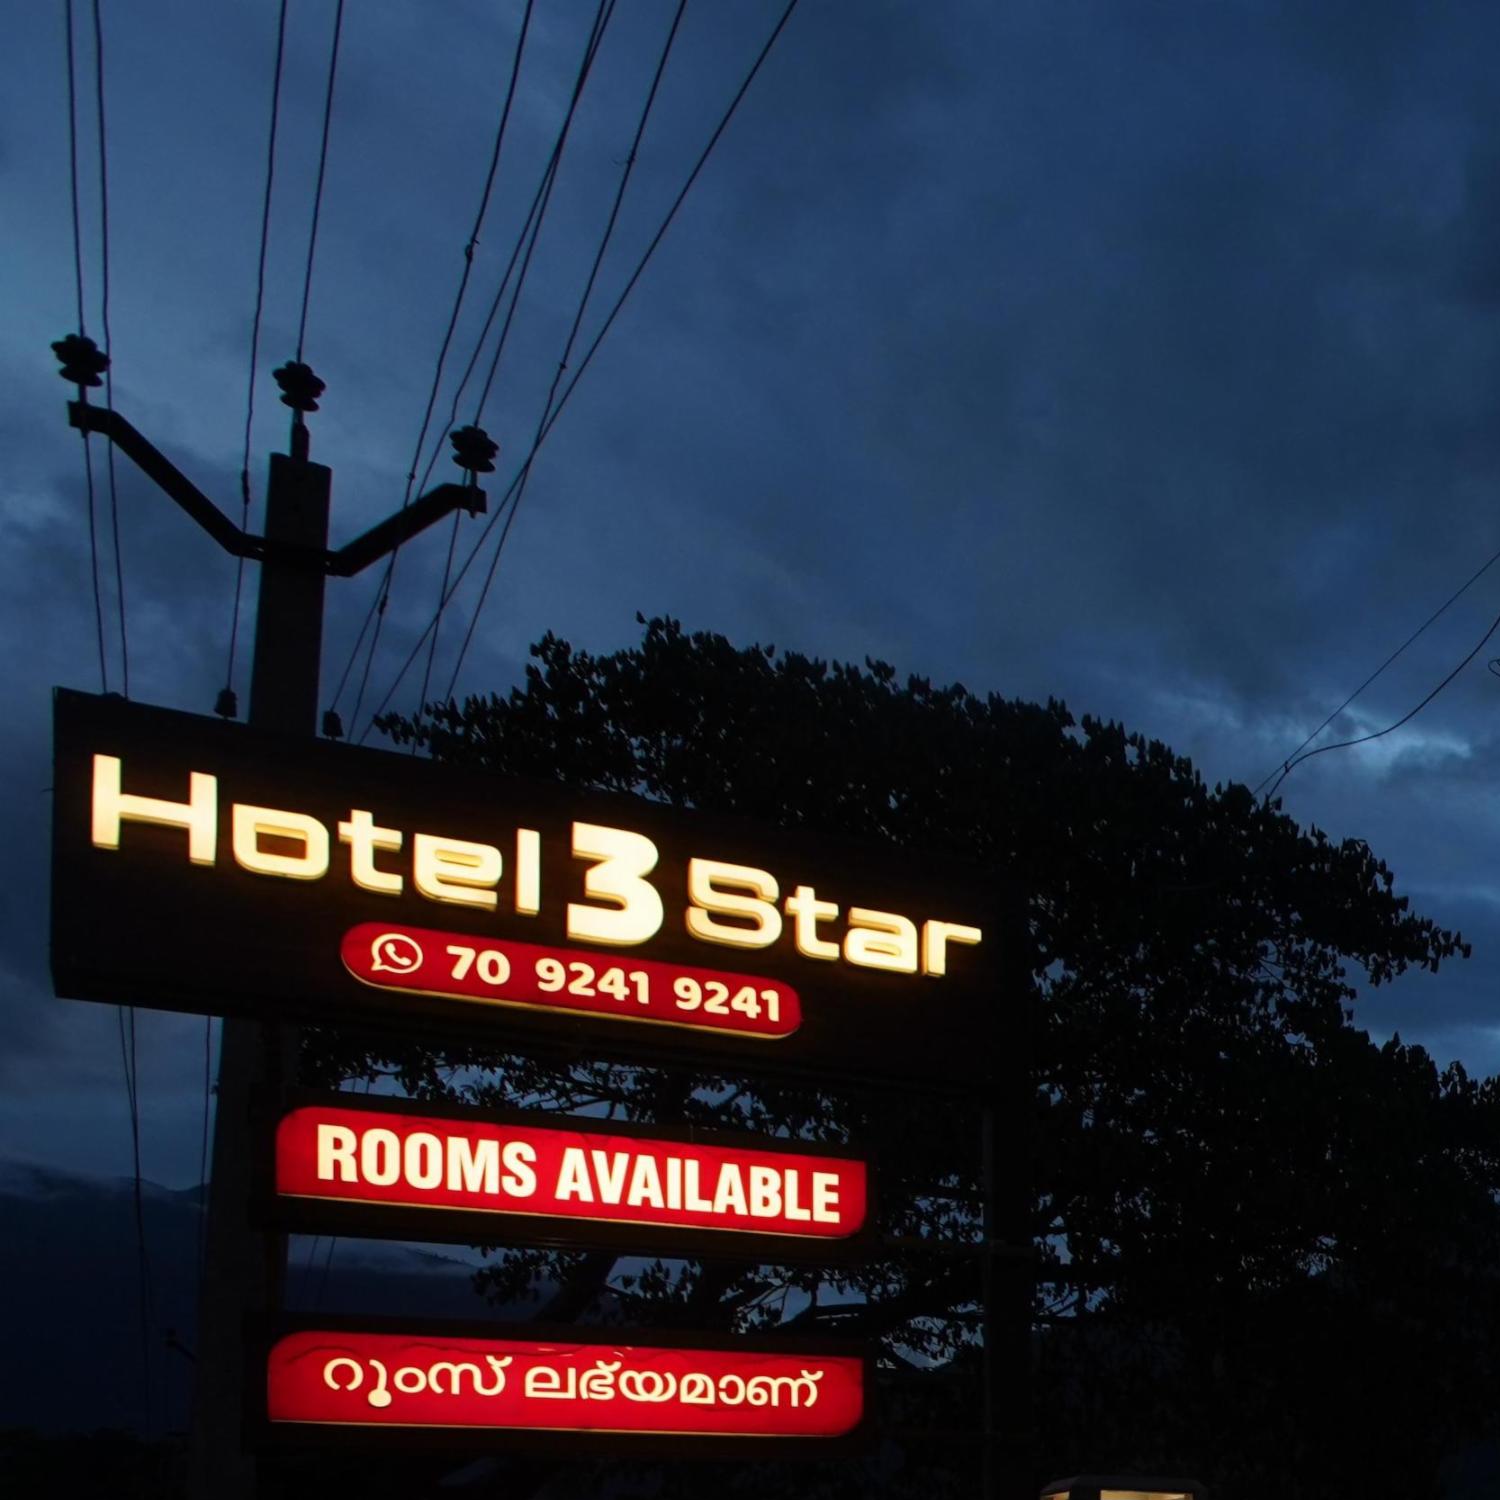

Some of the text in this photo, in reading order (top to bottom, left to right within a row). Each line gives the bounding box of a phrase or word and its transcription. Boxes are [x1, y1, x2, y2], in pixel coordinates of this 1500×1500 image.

[92, 754, 982, 976] Hotel 3 Star
[447, 945, 779, 1022] 70 9241 9241
[317, 1124, 840, 1223] ROOMS AVAILABLE
